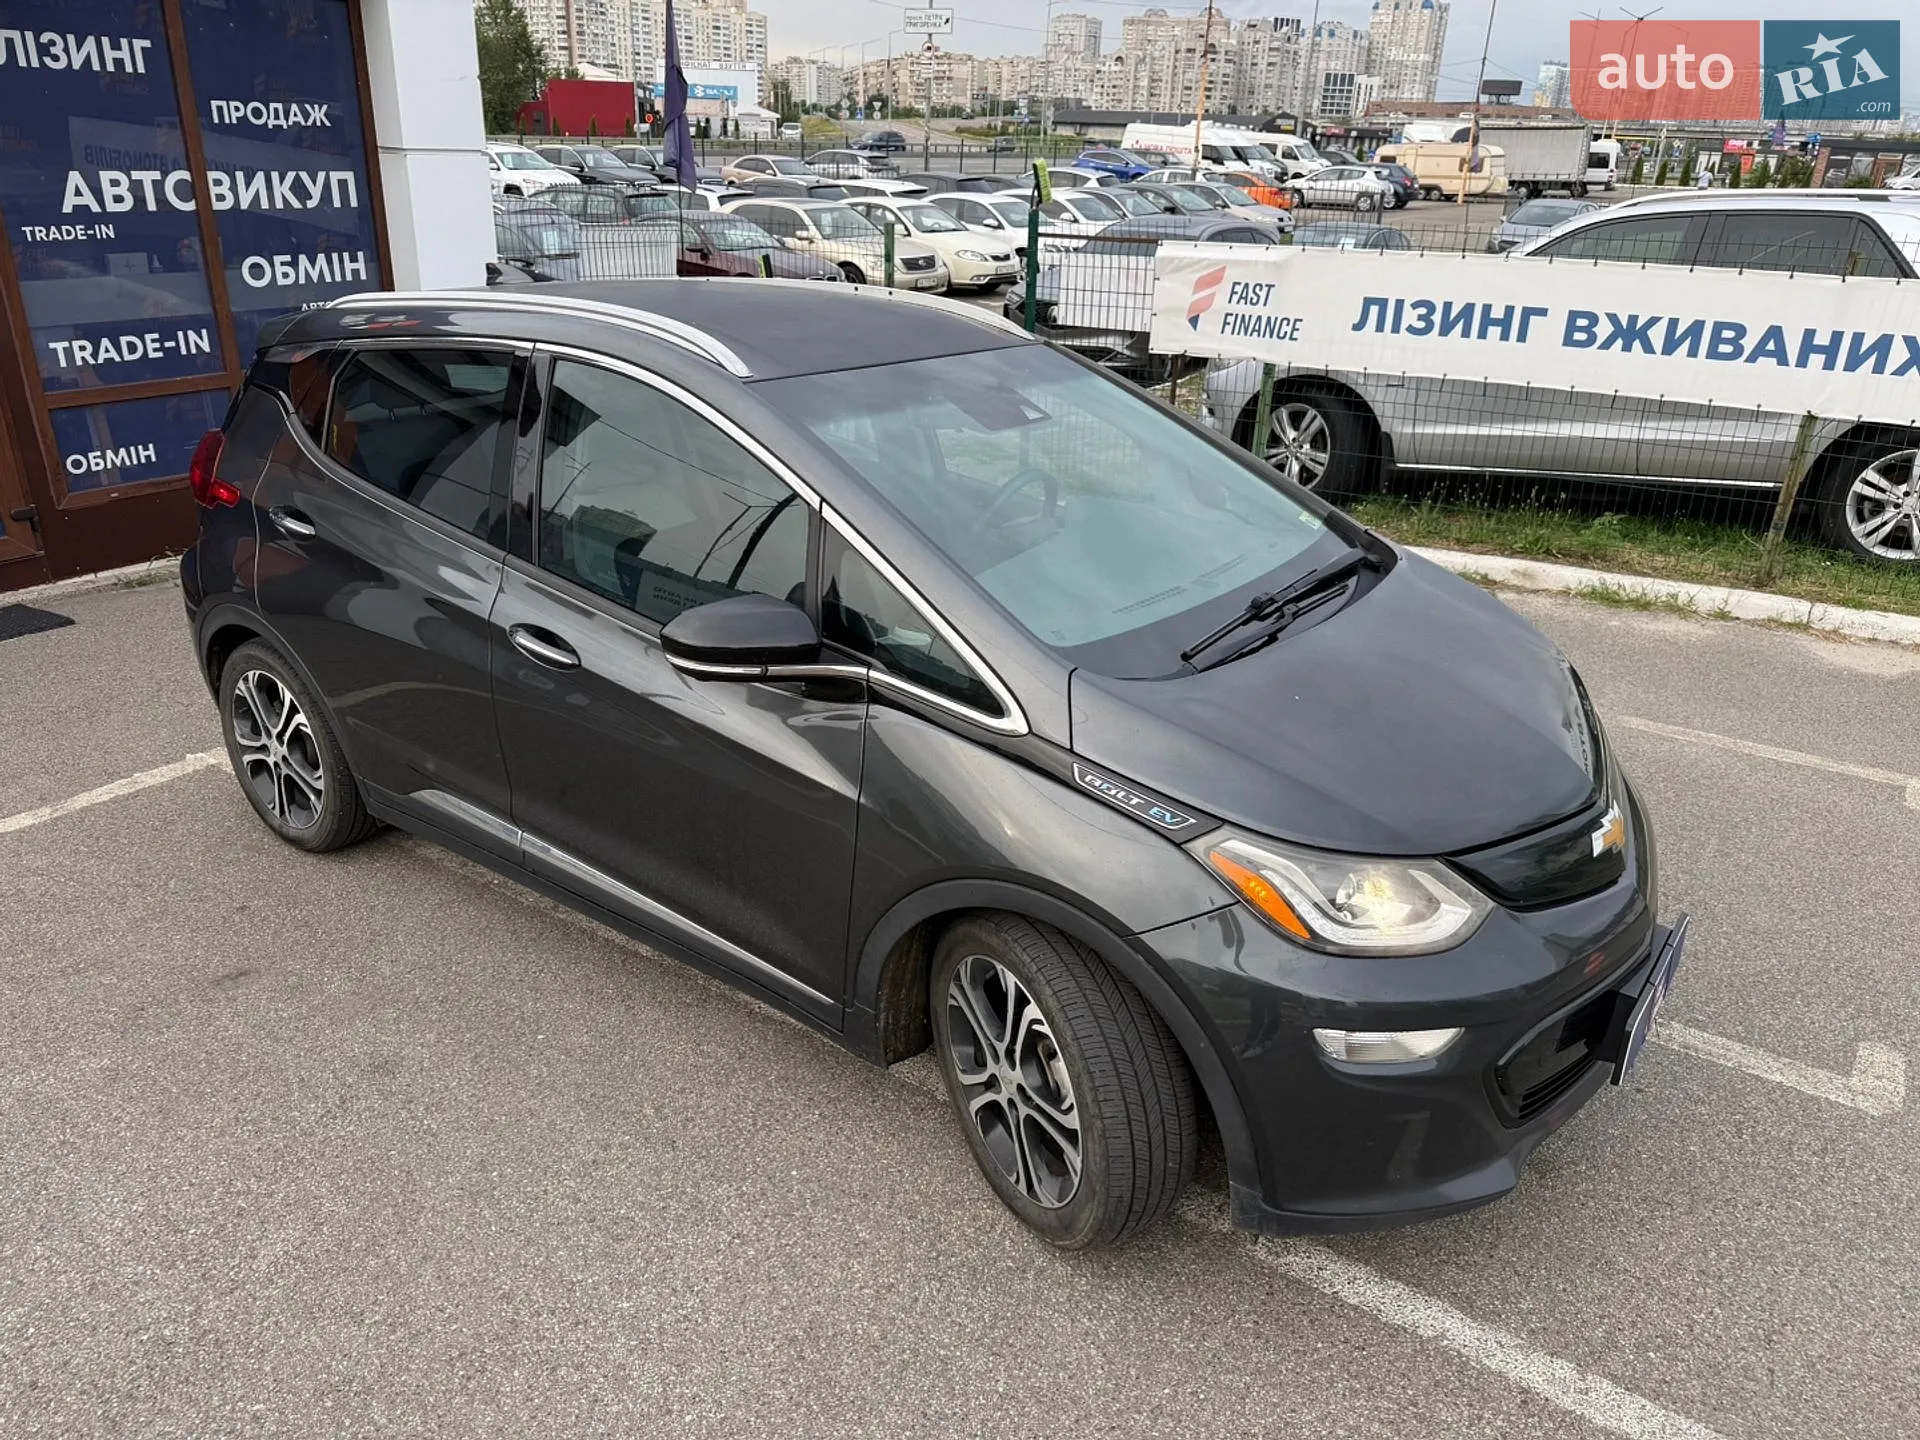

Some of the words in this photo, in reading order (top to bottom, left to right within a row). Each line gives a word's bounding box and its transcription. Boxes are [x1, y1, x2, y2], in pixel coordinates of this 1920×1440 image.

[0, 29, 151, 74] ЛІЗИНГ
[210, 100, 331, 129] ПРОДАЖ
[22, 224, 116, 242] TRADE-IN
[241, 251, 367, 288] ОБМІН
[1228, 281, 1275, 307] FAST
[1220, 312, 1304, 342] FINANCE
[1352, 296, 1549, 344] ЛІЗИНГ
[1561, 309, 1920, 377] ВЖИВАНИХ
[49, 328, 211, 368] TRADE-IN
[66, 443, 157, 475] ОБМІН
[1083, 774, 1145, 806] BOLT
[1147, 806, 1181, 824] EV
